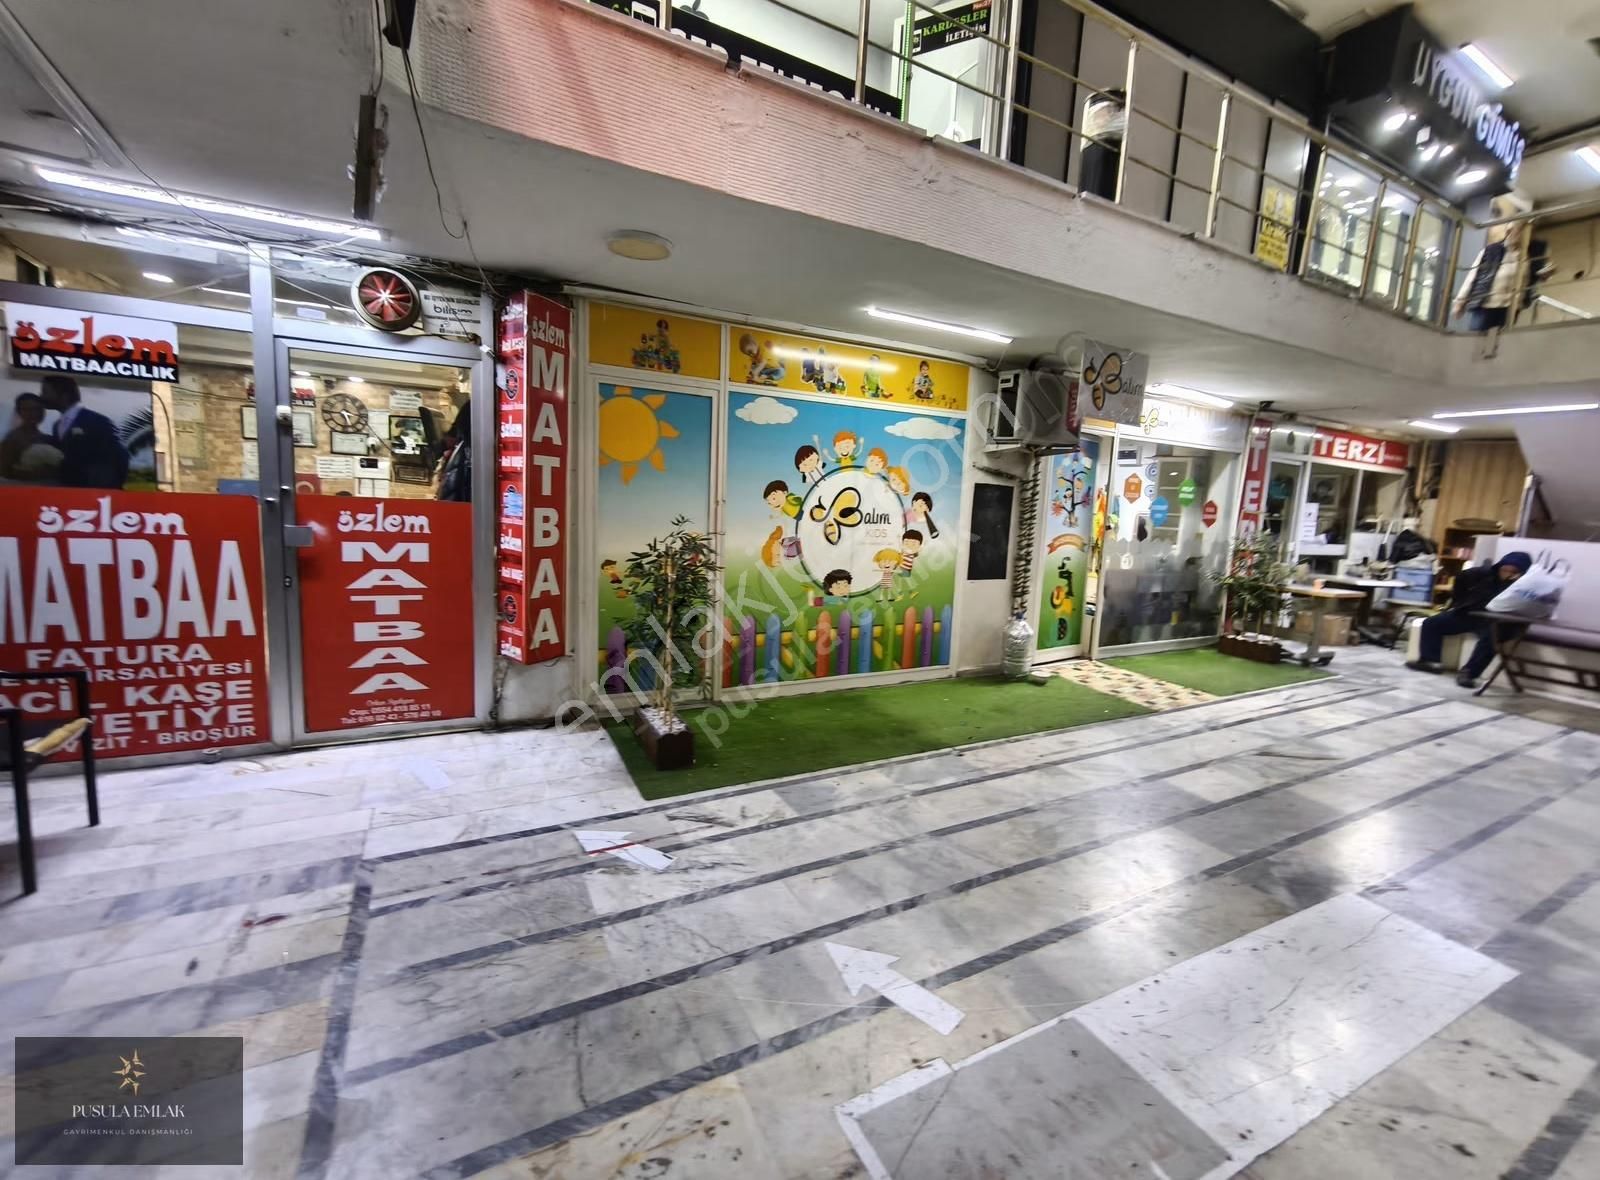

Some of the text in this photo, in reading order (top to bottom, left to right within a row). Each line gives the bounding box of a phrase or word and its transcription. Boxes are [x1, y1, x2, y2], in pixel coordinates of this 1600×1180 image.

[14, 316, 177, 366] özlem
[532, 311, 565, 348] özlem
[20, 352, 176, 380] MATBAACILIK
[1319, 434, 1386, 465] TERZİ
[530, 344, 565, 649] MATBAA
[37, 496, 188, 536] özlem
[337, 502, 431, 534] özlem
[341, 541, 430, 694] MATBAA
[26, 643, 212, 669] FATURA
[123, 680, 254, 707] KAŞE
[157, 725, 256, 744] BROŞÜR
